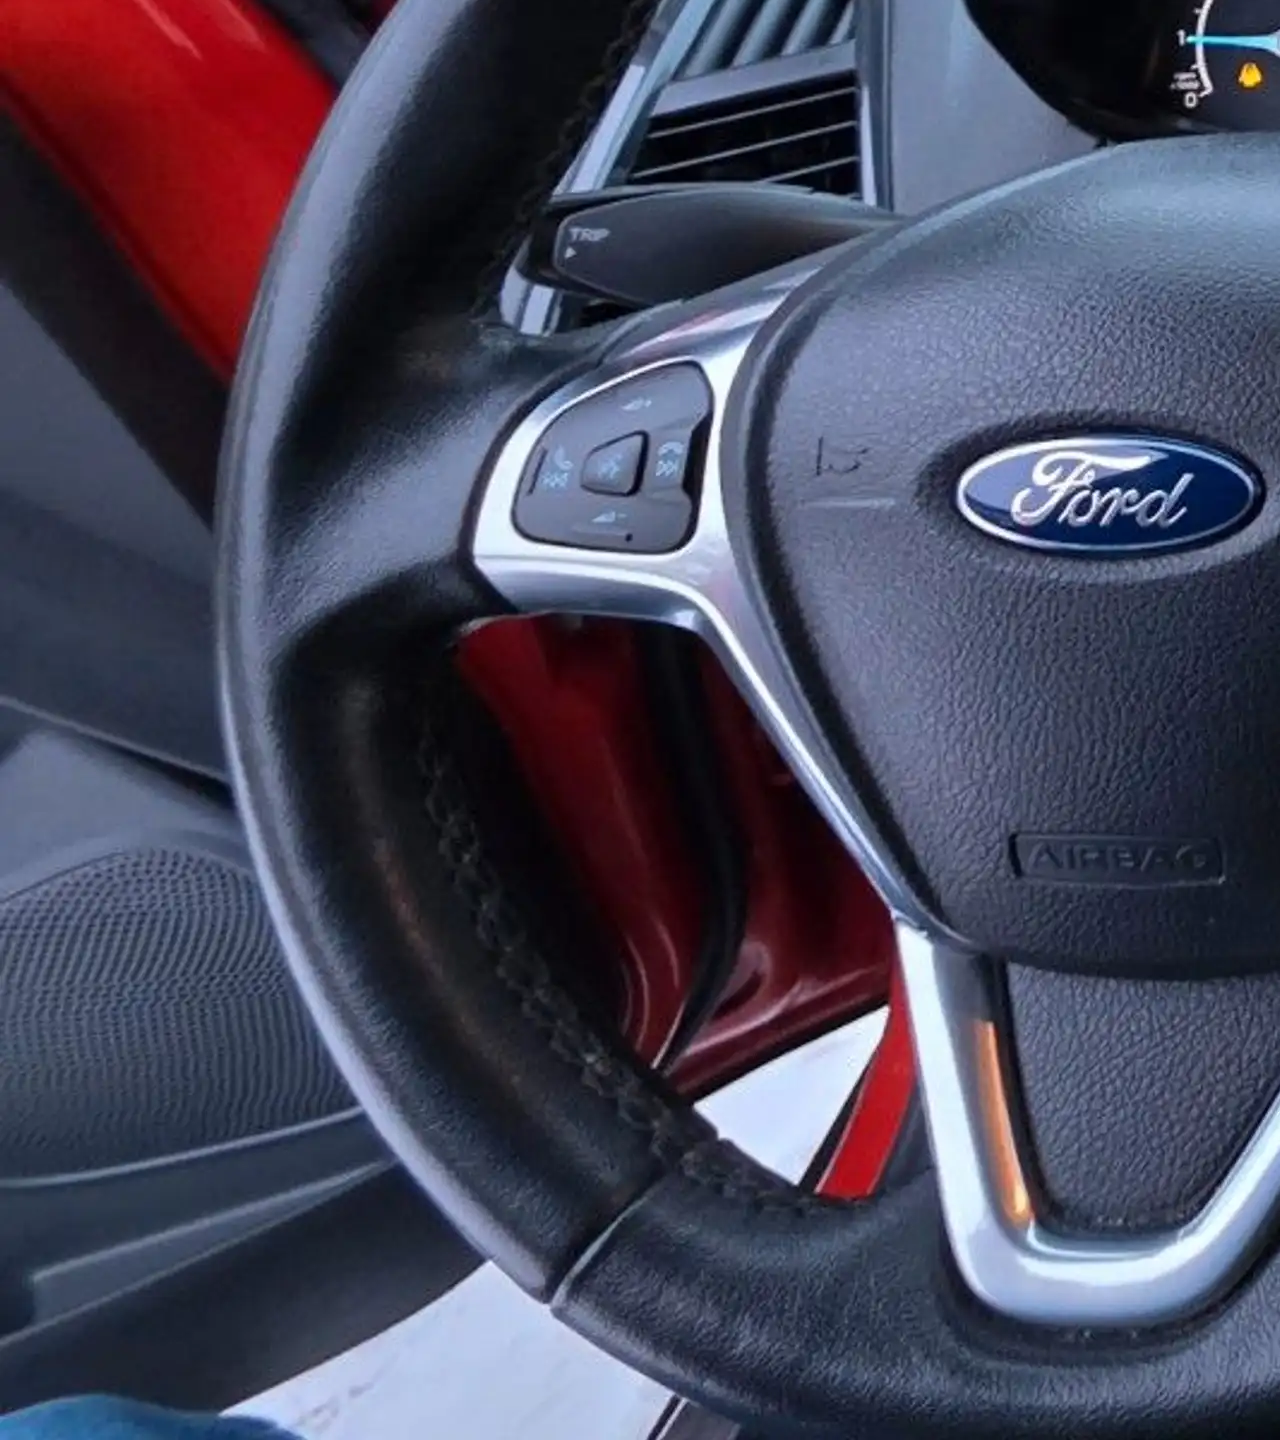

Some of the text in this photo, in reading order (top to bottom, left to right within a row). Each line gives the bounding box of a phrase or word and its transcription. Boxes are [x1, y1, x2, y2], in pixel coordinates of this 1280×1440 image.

[1177, 30, 1186, 46] 1
[1185, 93, 1198, 108] 0
[1010, 450, 1195, 528] Ford
